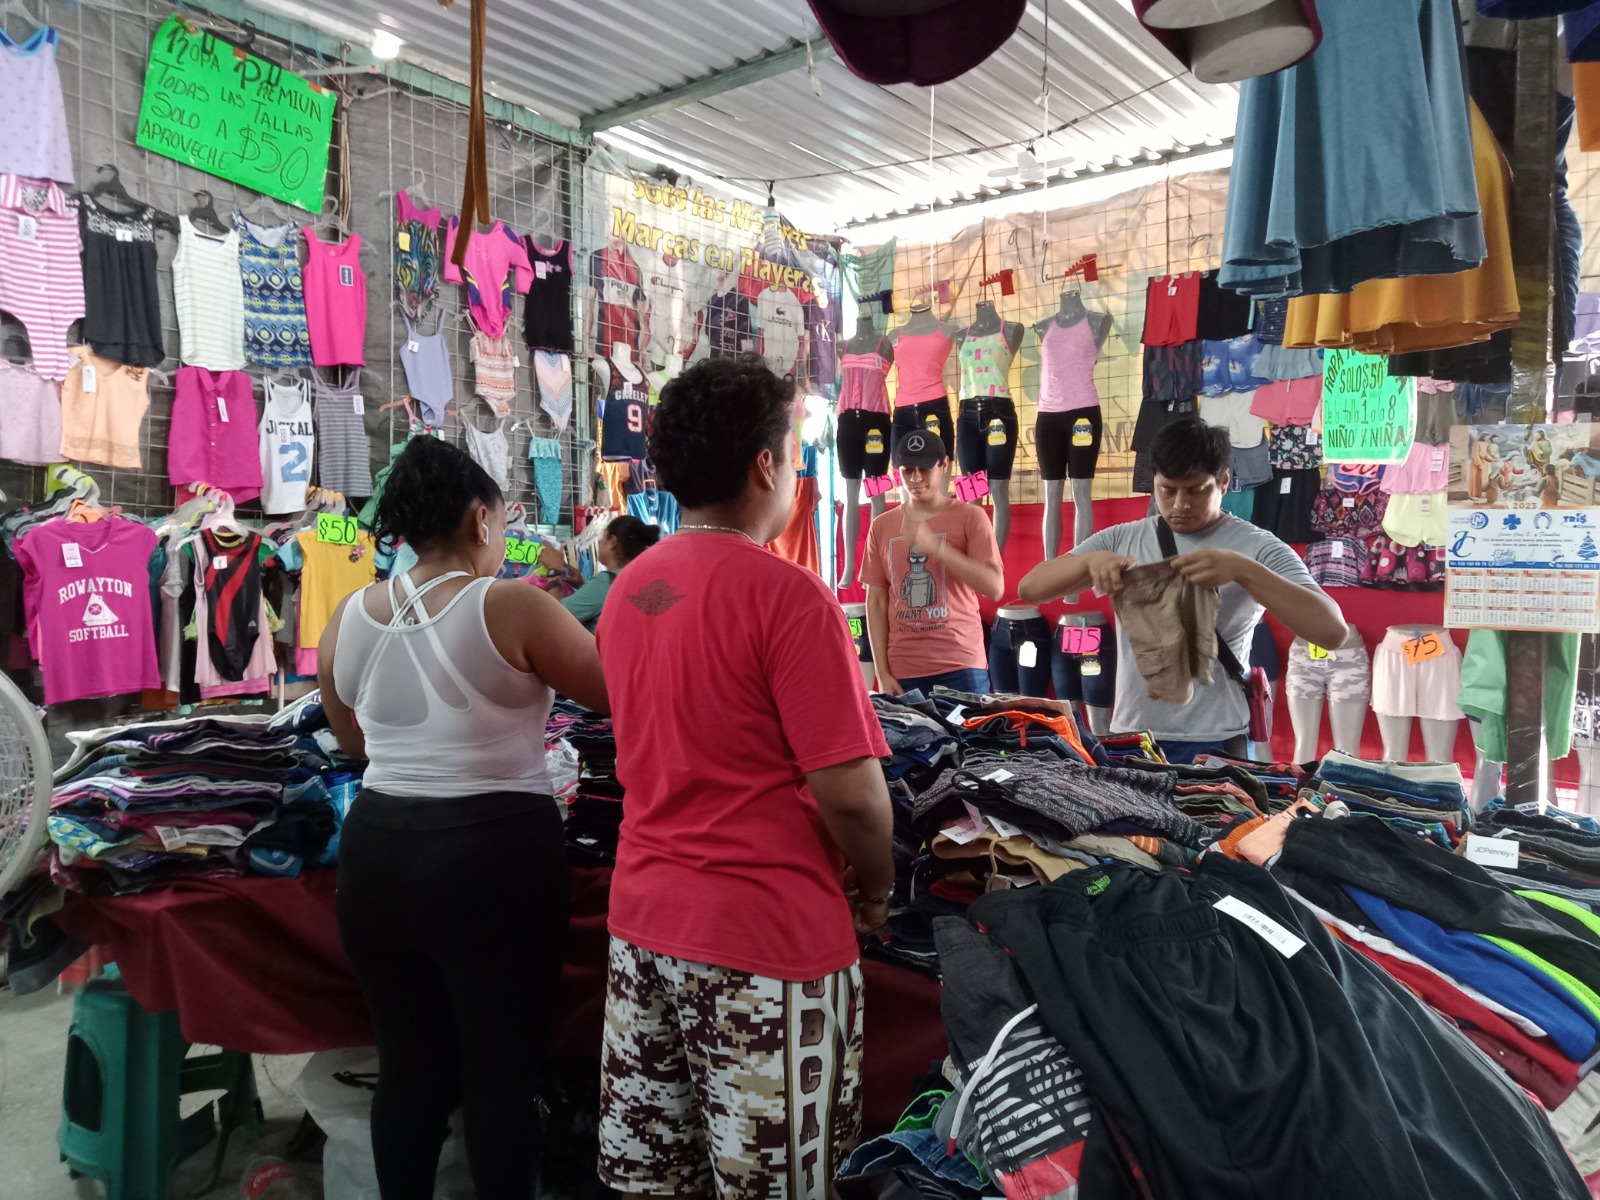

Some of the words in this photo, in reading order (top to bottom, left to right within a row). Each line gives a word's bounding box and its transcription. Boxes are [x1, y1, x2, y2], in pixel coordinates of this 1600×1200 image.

[166, 24, 220, 72] ROPA
[154, 58, 209, 102] TODAS
[221, 87, 245, 108] LAS
[251, 99, 314, 142] TALLAS
[140, 120, 229, 171] APROVECHE
[151, 92, 200, 129] SOLO
[216, 119, 228, 140] A
[231, 124, 310, 190] $50
[691, 186, 726, 223] las
[612, 206, 700, 264] Marcas
[705, 244, 733, 272] en
[739, 246, 825, 298] Playeras
[1339, 365, 1361, 394] SOLO
[626, 403, 643, 433] 9
[1360, 399, 1369, 425] 1
[1387, 394, 1397, 421] 8
[1328, 424, 1355, 449] NIÑO
[1369, 421, 1407, 448] NIÑA
[278, 441, 308, 484] 2
[319, 518, 357, 545] $50
[57, 576, 133, 605] ROWAYTON
[926, 607, 948, 619] YOU
[68, 624, 130, 643] SOFTBALL
[1063, 628, 1100, 653] 175
[1474, 846, 1511, 858] JCPenney
